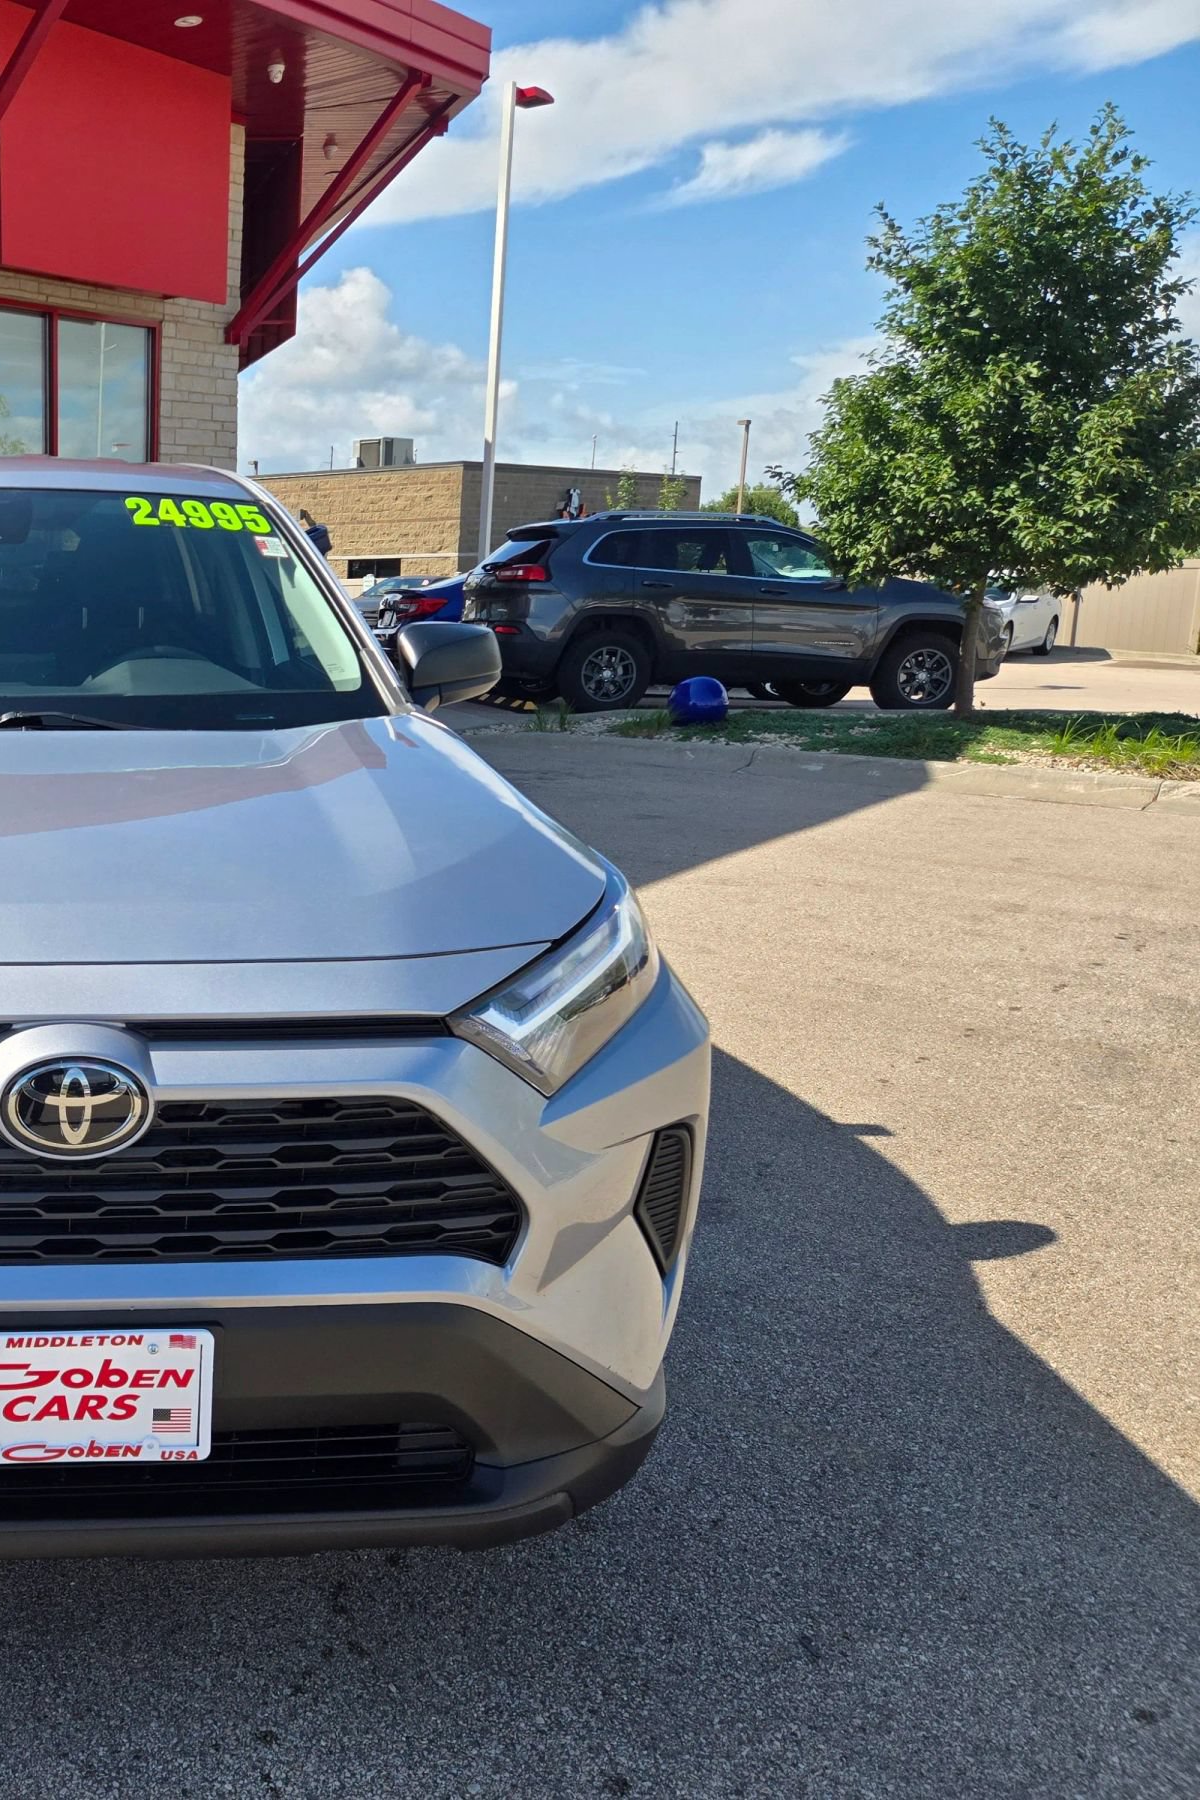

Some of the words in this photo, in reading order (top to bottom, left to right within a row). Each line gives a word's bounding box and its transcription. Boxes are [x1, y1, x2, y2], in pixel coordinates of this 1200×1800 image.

[124, 497, 272, 534] 24995
[5, 1335, 144, 1348] MIDDLETON
[2, 1394, 141, 1422] CARS
[160, 1450, 198, 1461] USA
